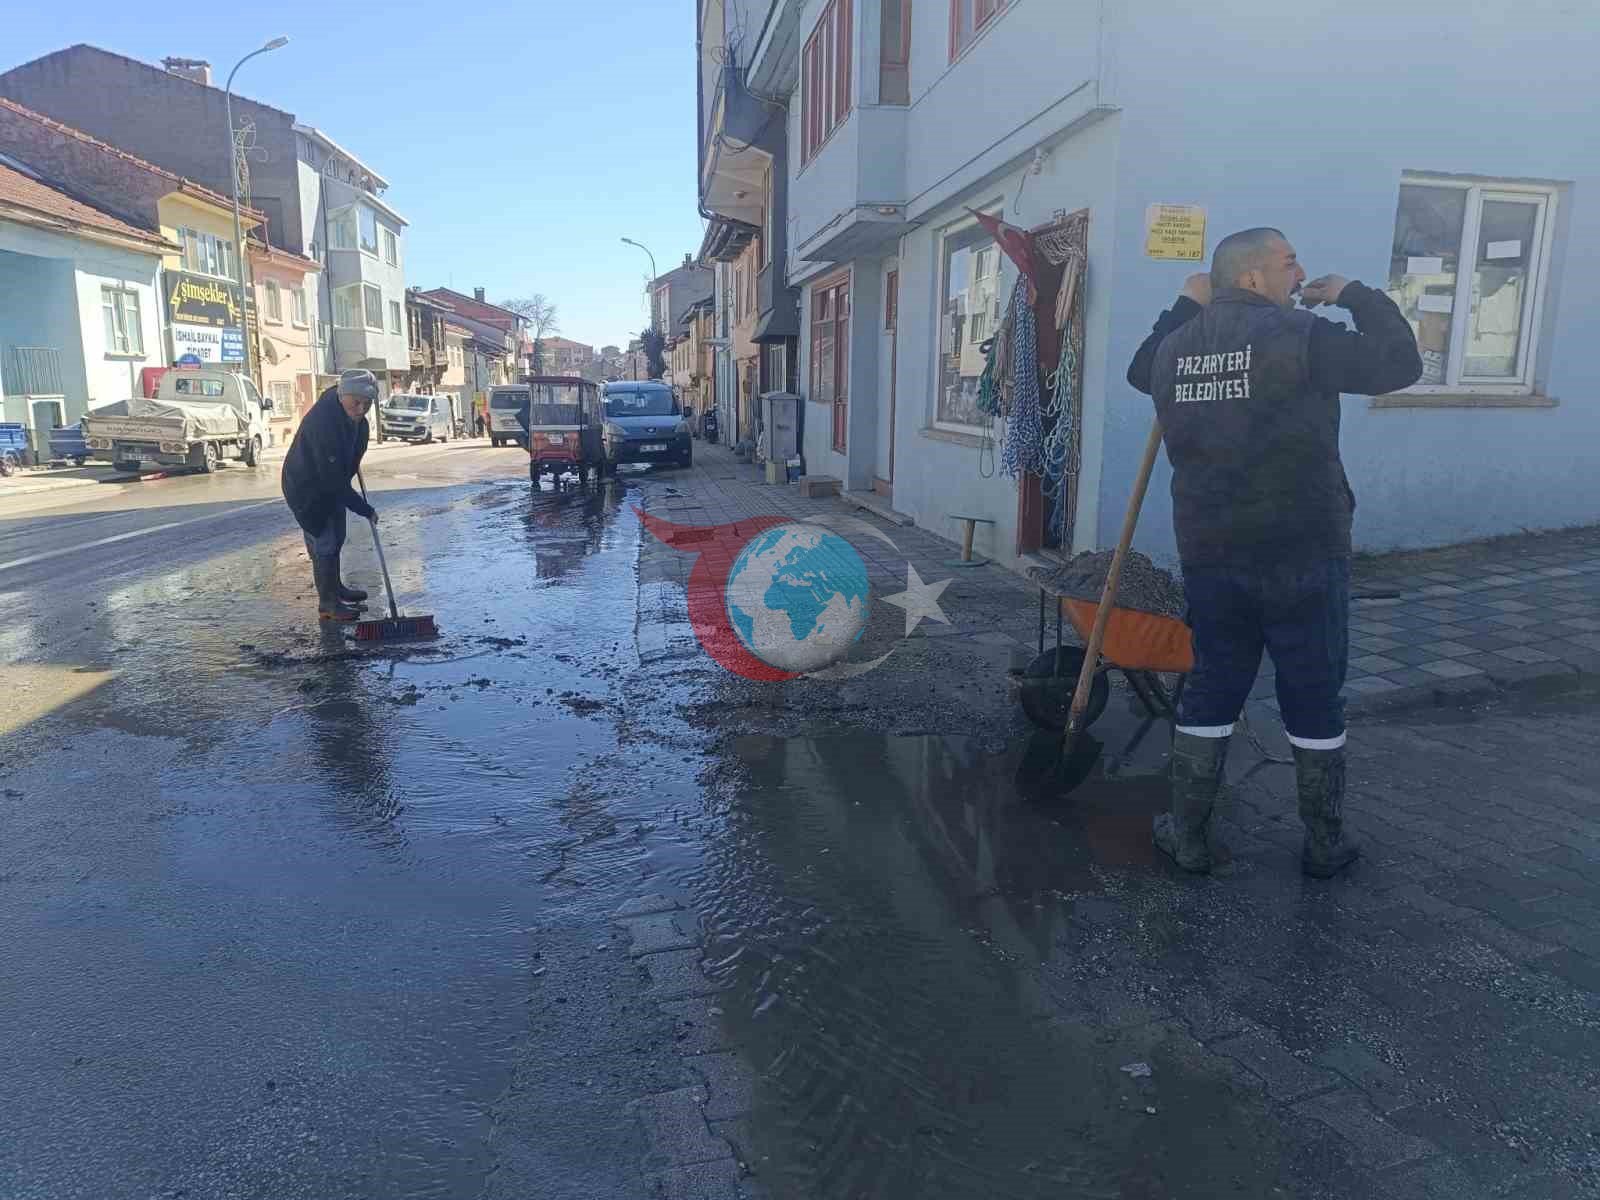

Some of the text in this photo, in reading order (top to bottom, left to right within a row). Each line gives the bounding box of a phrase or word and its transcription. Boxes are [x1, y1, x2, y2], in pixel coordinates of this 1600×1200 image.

[181, 278, 228, 306] şimşekler
[1176, 343, 1252, 376] PAZARYERİ
[1175, 372, 1251, 403] BELEDİYESİ
